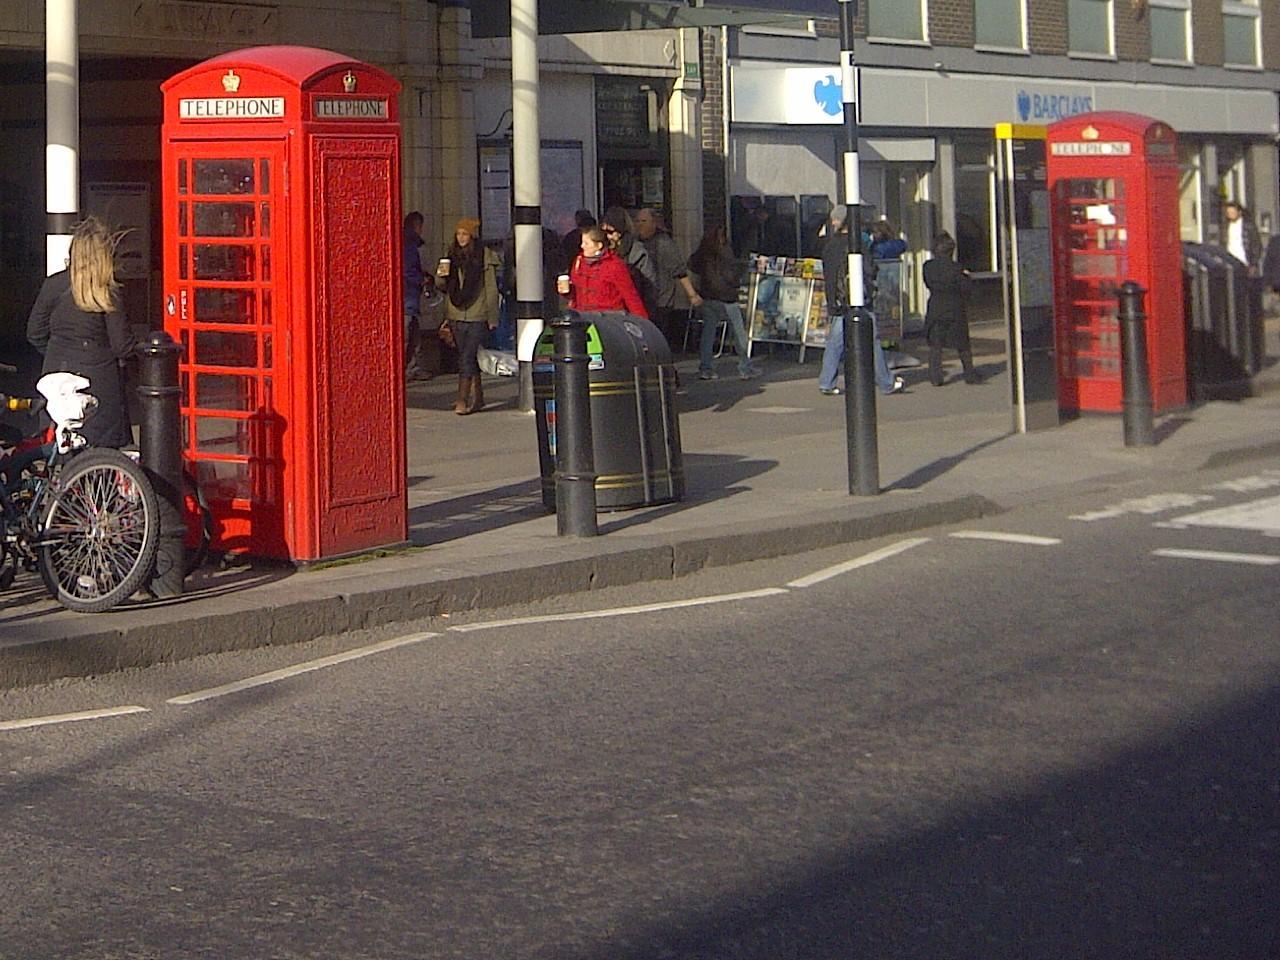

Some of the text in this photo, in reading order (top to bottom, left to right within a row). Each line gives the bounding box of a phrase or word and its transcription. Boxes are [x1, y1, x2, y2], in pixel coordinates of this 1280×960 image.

[183, 99, 280, 116] TELEPHONE
[316, 100, 384, 116] TELEPHONE
[1033, 94, 1092, 120] BARCLAYS
[1055, 143, 1126, 154] TELEPHNE
